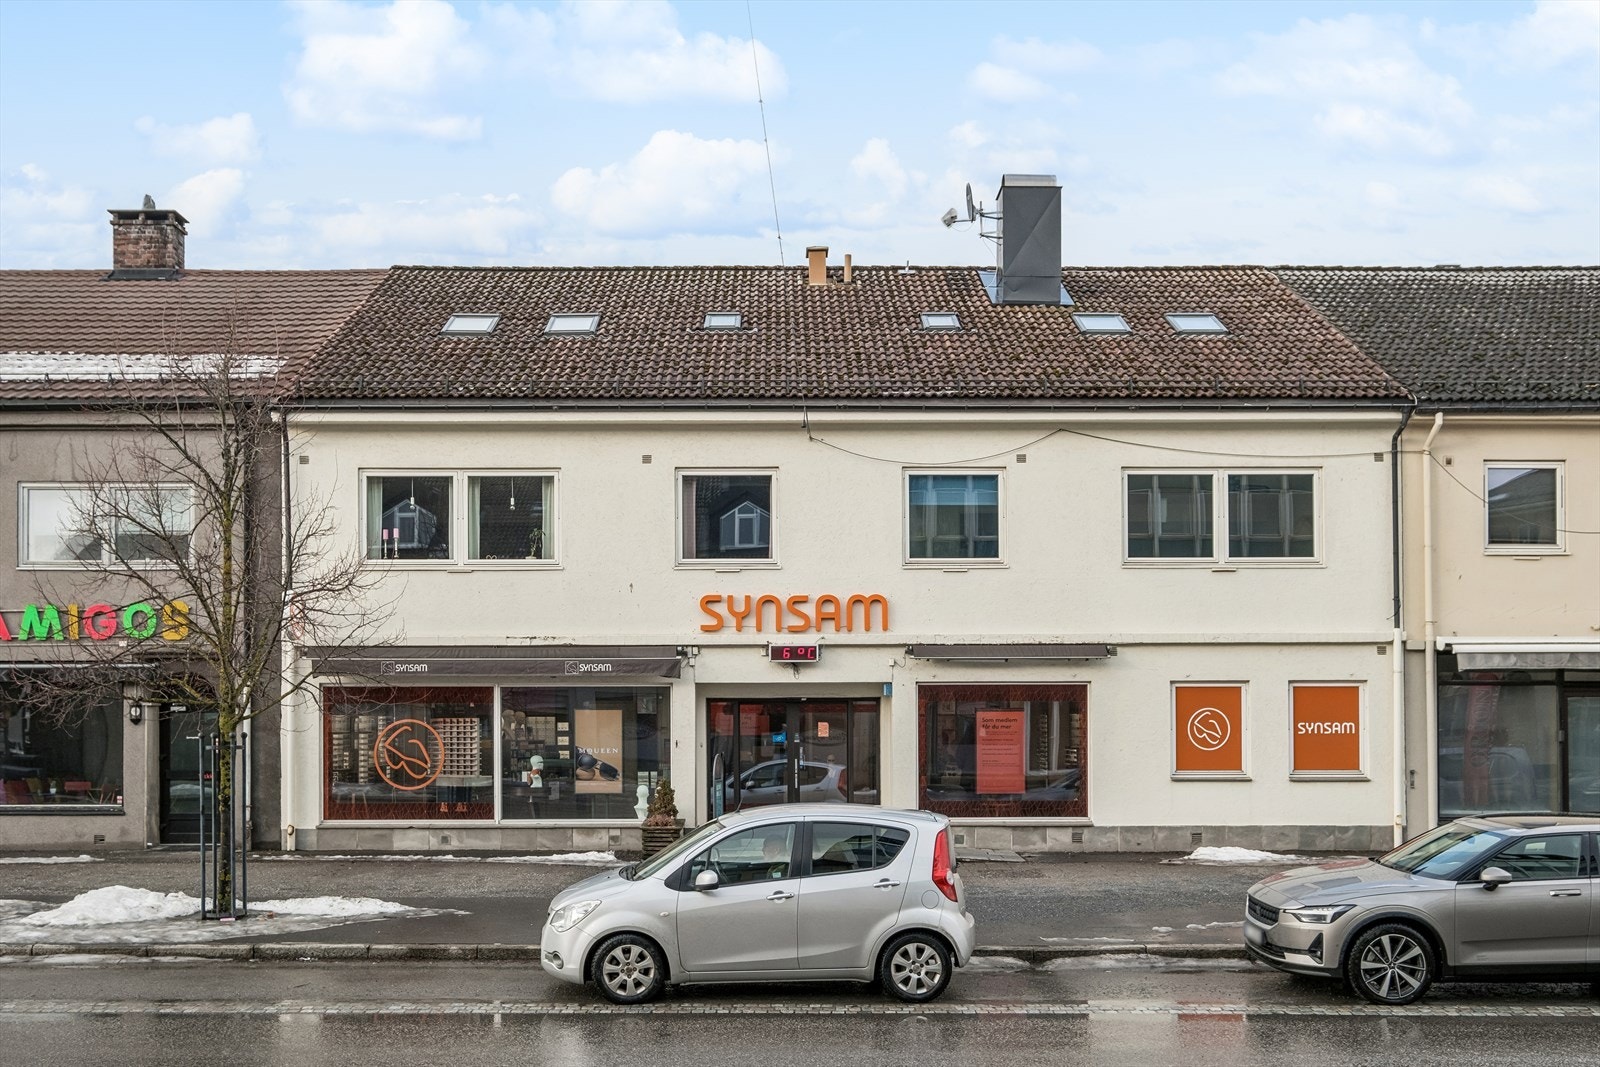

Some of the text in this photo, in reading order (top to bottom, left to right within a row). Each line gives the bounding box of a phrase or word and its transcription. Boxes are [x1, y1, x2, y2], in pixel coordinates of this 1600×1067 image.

[700, 595, 888, 633] SYNSAM
[783, 647, 791, 659] 6
[395, 663, 428, 672] SYNSAM
[579, 663, 612, 672] SYNSAM
[1297, 722, 1356, 735] SYNSAM
